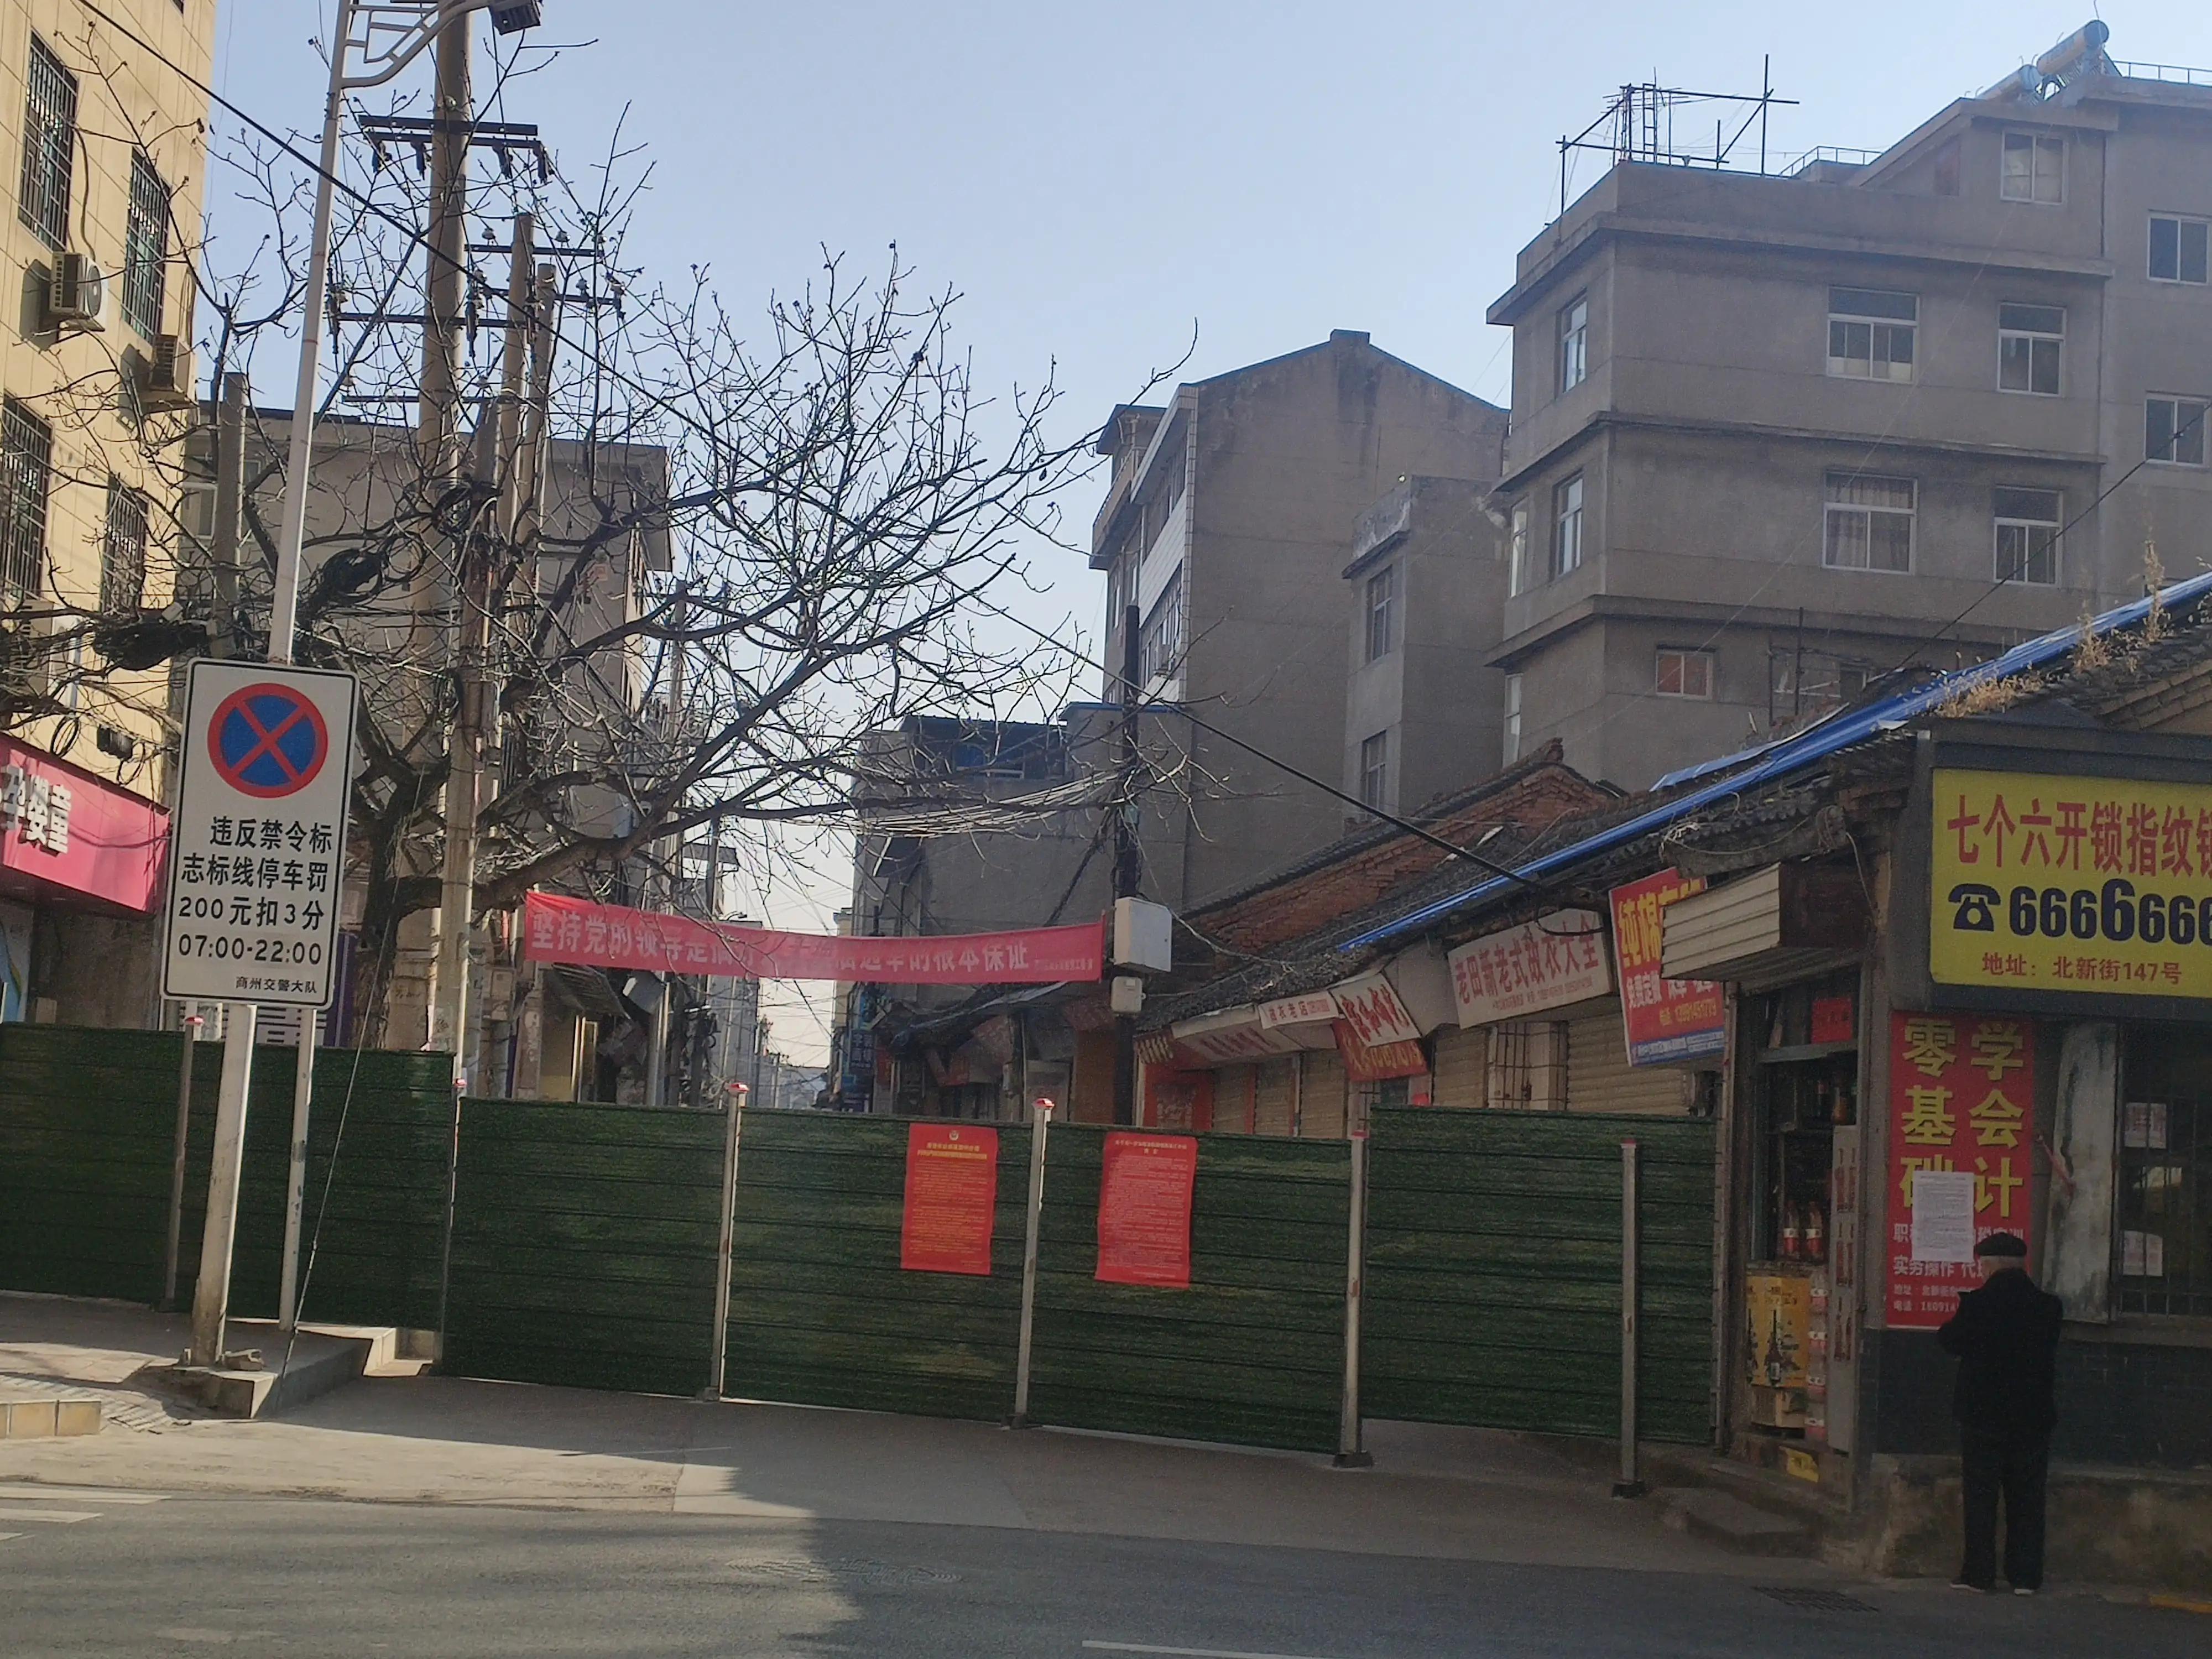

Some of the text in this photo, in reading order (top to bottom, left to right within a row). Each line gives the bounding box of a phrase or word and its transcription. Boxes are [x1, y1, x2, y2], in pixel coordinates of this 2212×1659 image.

[210, 816, 333, 854] 违反禁令标
[181, 853, 328, 893] 志标线停车罚
[178, 896, 325, 931] 200元扣3分
[178, 933, 322, 966] 07:00-22:00
[235, 976, 318, 995] 商州交警大队
[1969, 1022, 2024, 1218] 学会计
